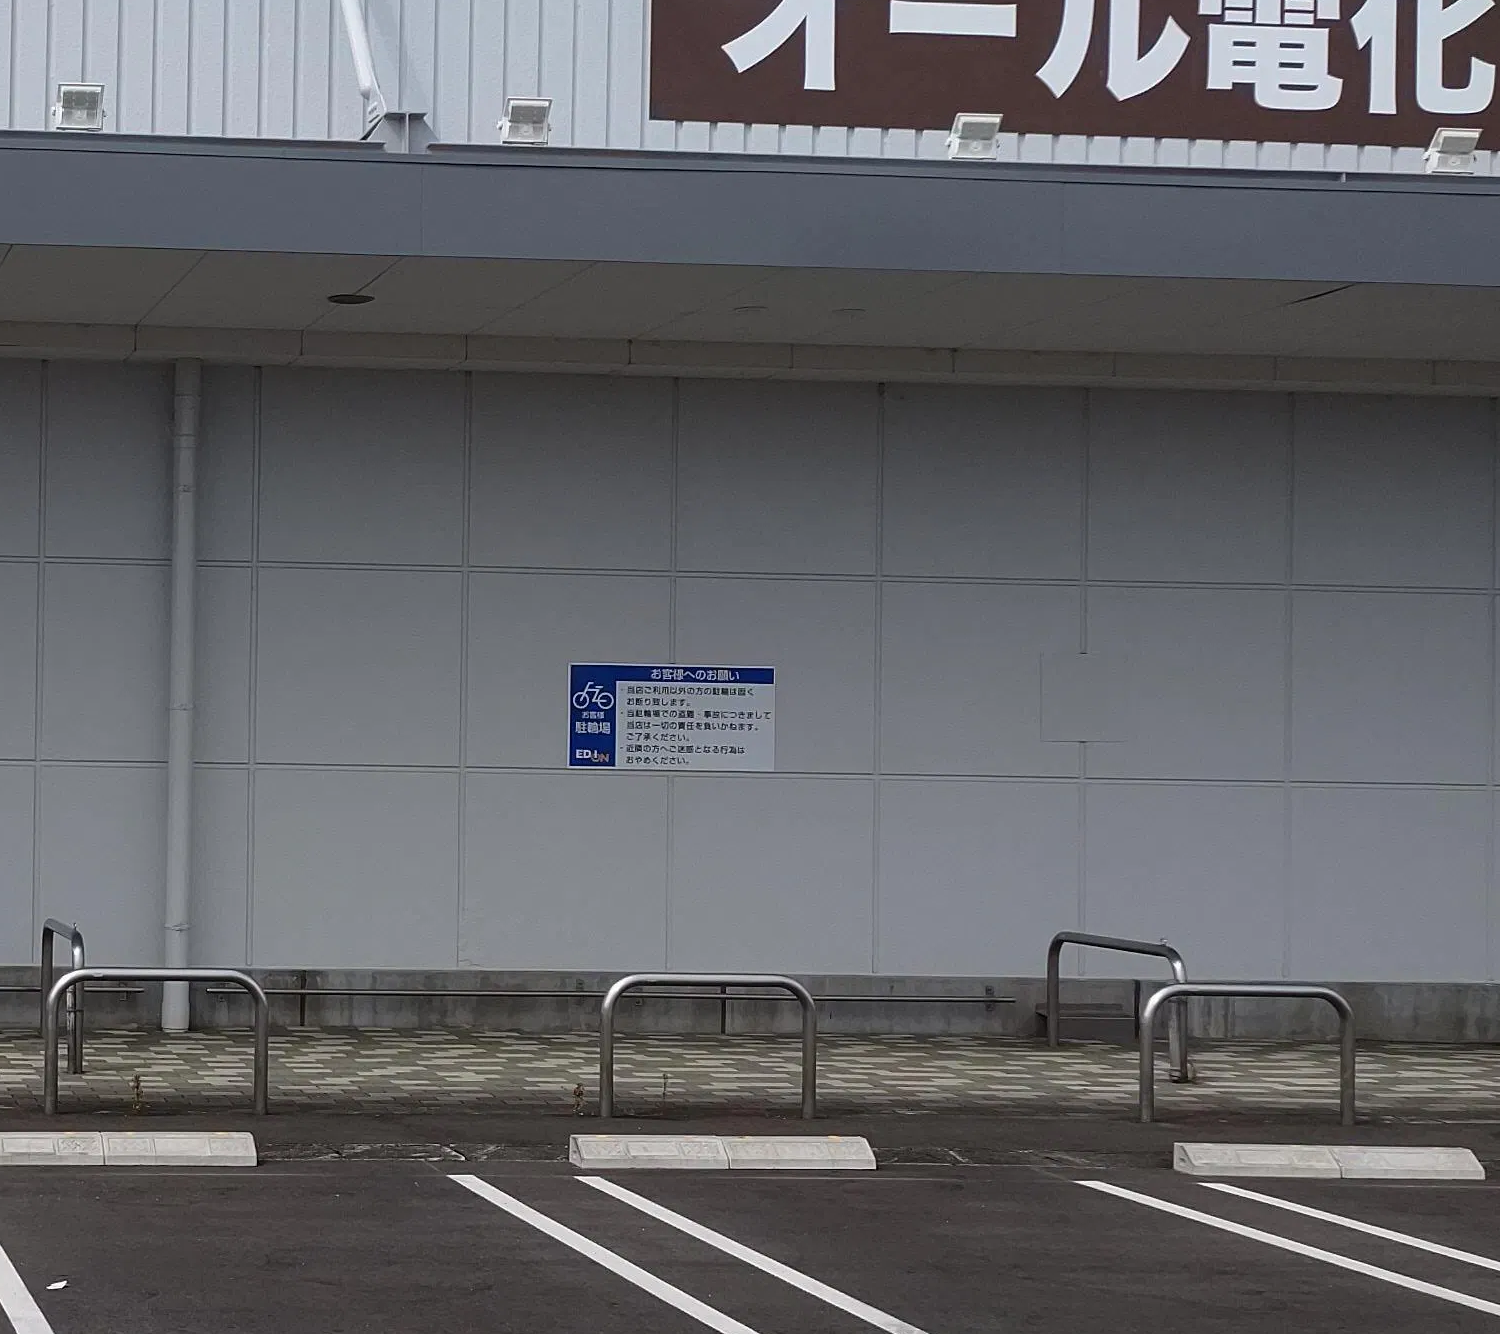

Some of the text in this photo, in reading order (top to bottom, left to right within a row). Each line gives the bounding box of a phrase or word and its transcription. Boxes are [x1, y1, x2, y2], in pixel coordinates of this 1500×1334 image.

[650, 668, 741, 681] お客様へのお願い
[575, 721, 611, 735] 駐輪場
